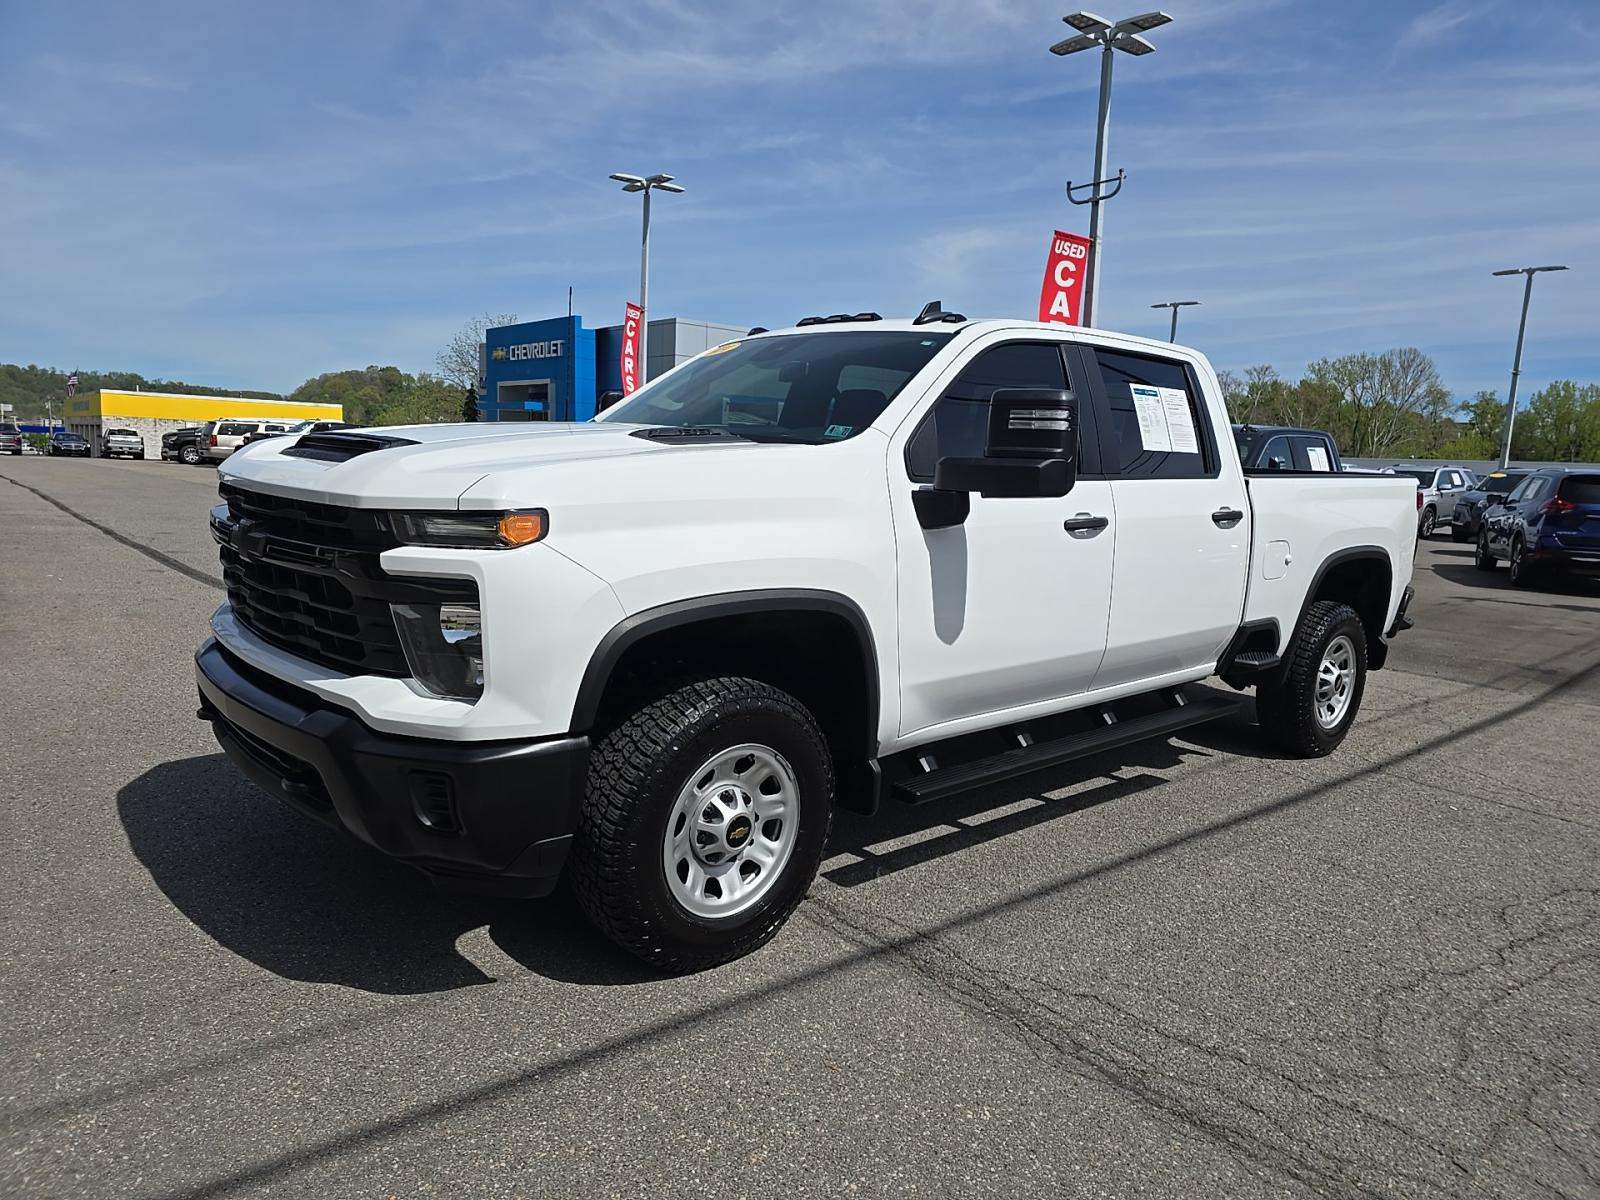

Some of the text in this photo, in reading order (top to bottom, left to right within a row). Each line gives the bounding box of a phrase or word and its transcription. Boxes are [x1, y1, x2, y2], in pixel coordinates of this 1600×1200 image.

[1055, 239, 1086, 259] USED
[1049, 260, 1076, 325] CA
[510, 340, 564, 361] CHEVROLET
[624, 320, 636, 393] CARS
